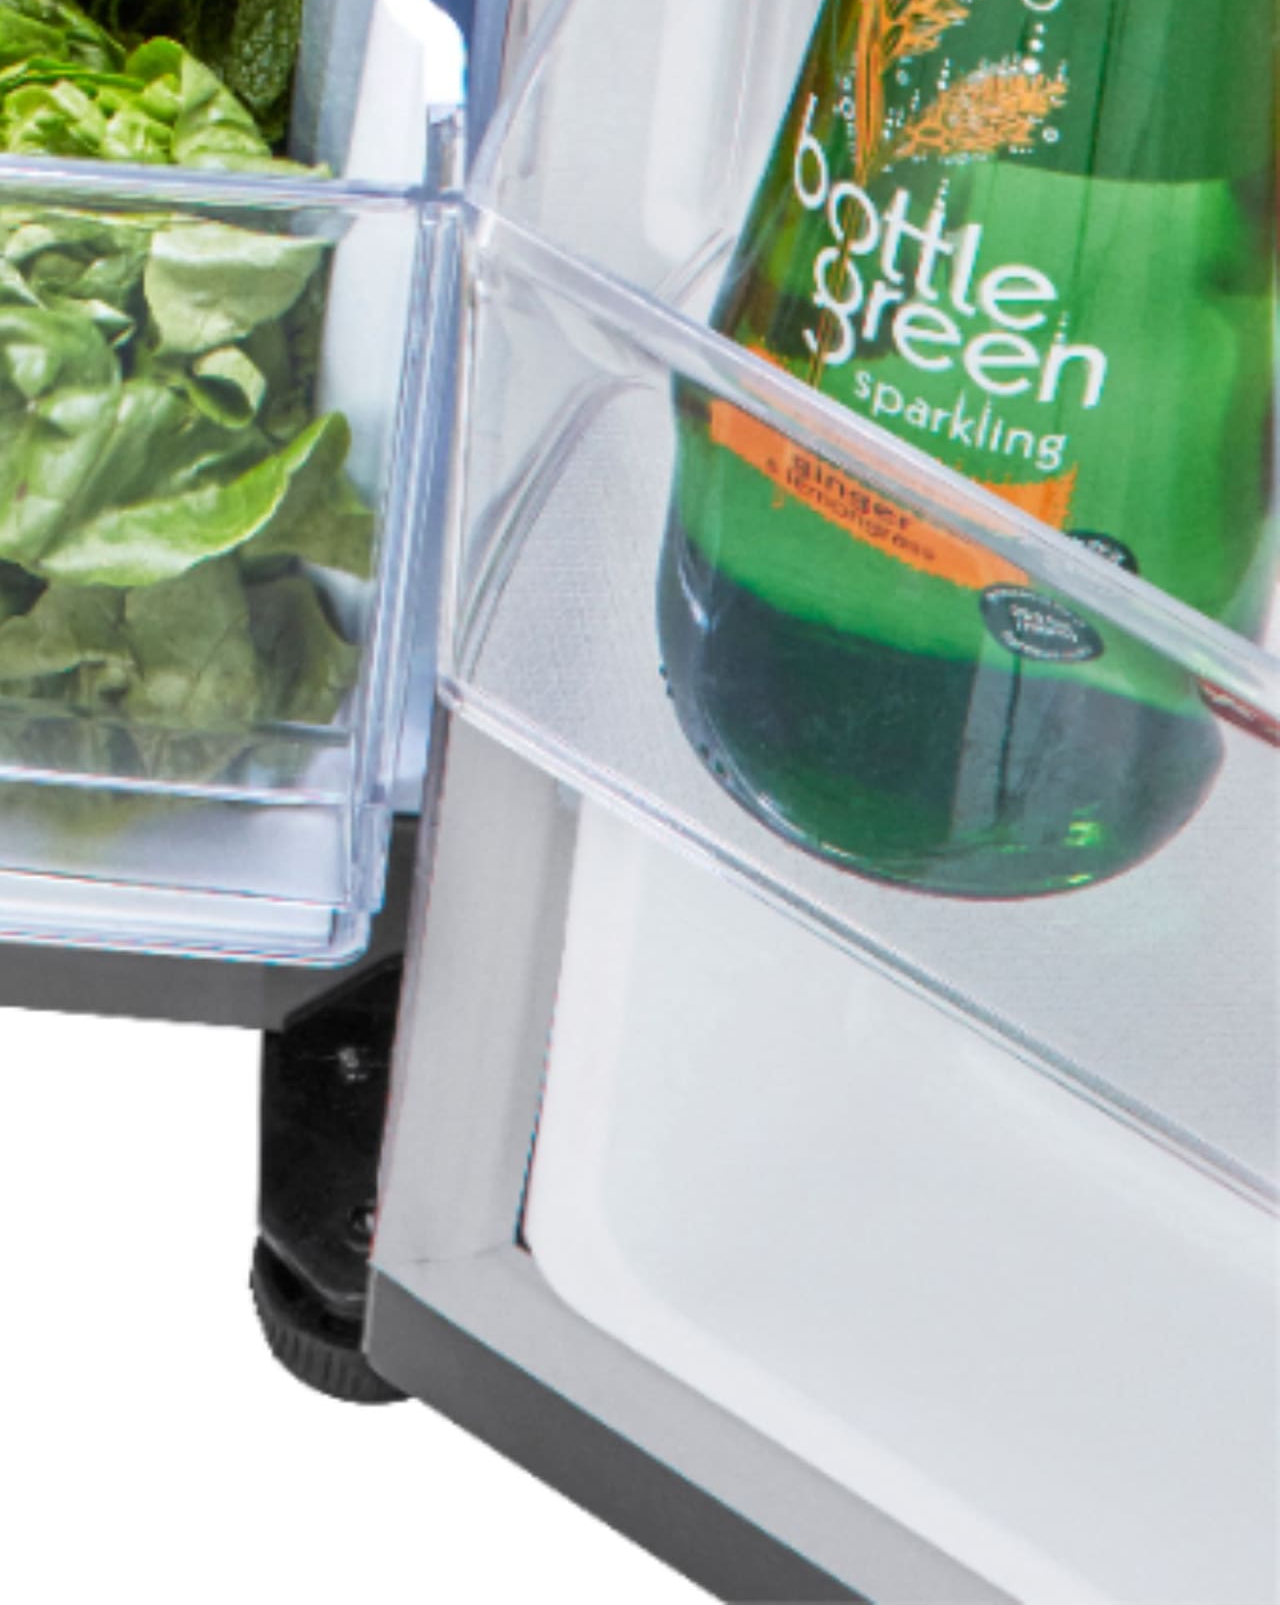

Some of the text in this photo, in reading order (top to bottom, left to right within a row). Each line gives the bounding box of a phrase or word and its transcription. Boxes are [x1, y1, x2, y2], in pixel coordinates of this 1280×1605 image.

[793, 92, 1057, 332] bottle
[802, 246, 1108, 408] green
[853, 368, 1068, 471] sparkling
[792, 452, 908, 532] ginger
